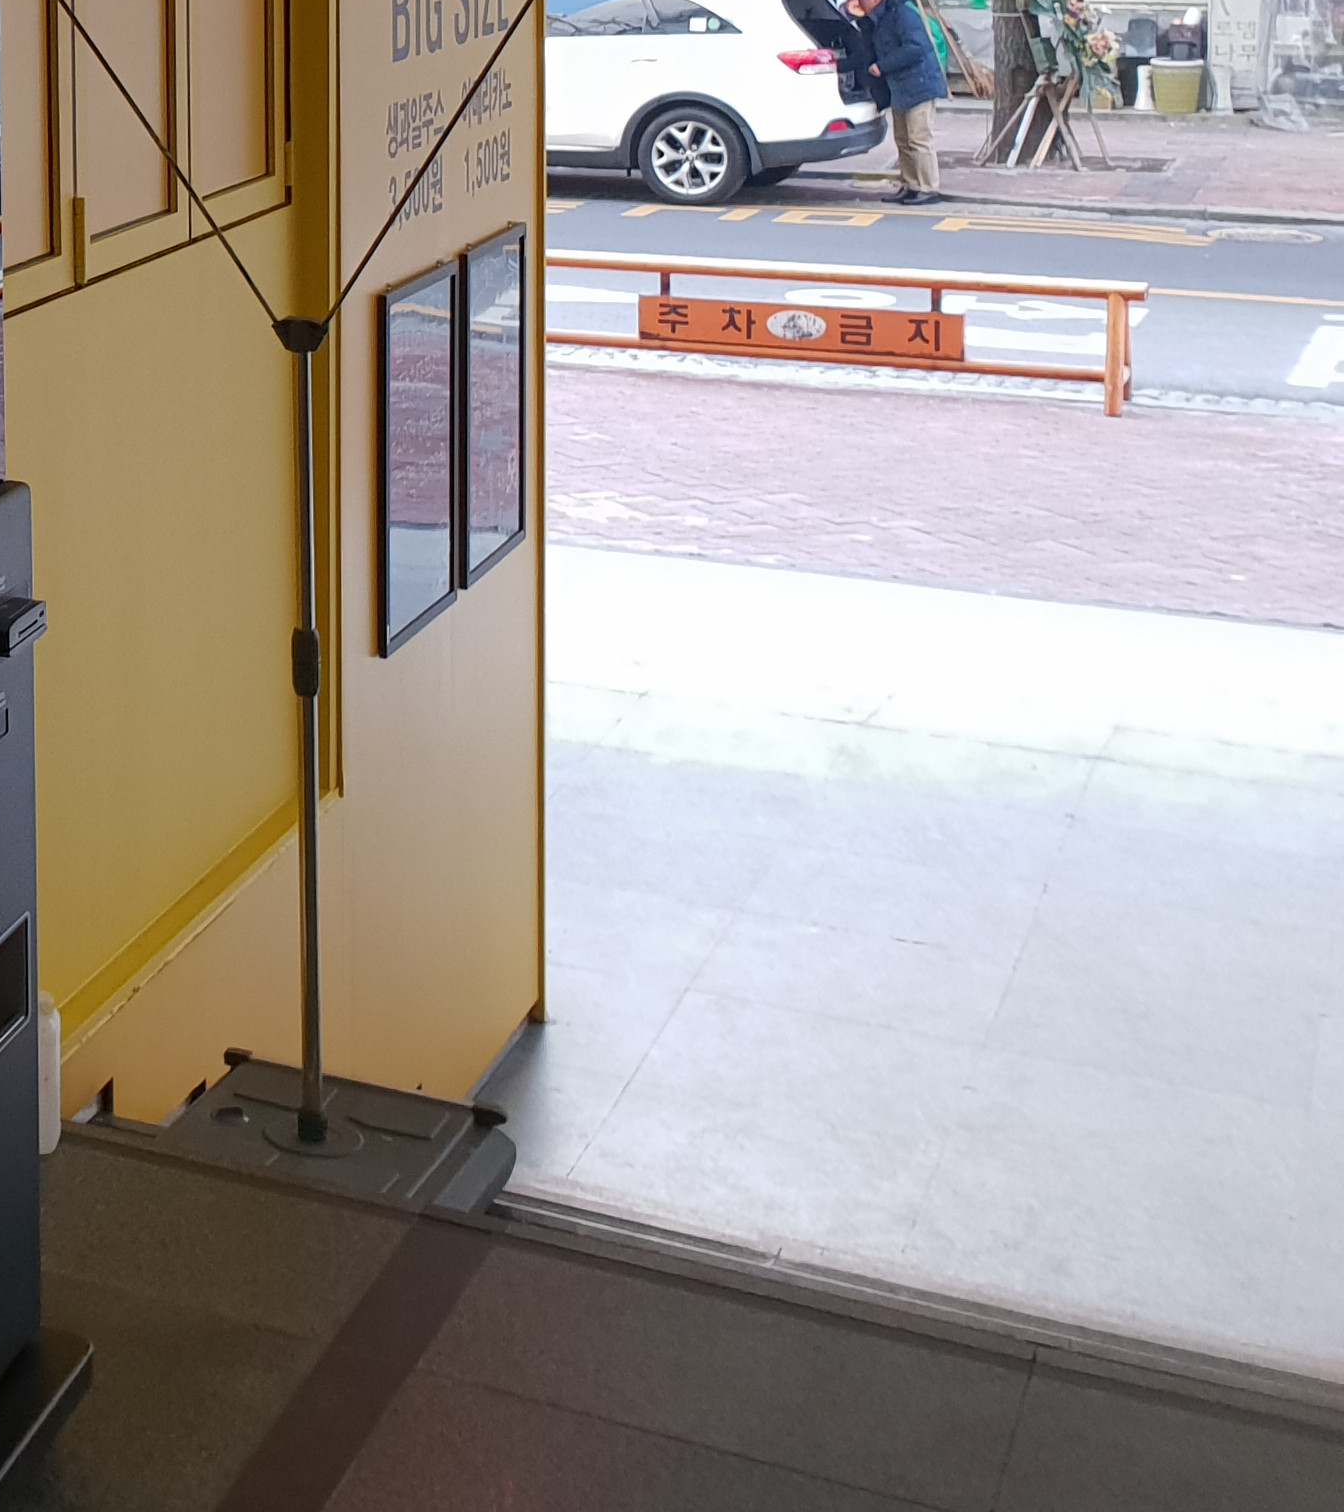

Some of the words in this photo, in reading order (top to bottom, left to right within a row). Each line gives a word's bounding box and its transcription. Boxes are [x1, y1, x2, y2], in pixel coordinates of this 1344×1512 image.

[385, 88, 446, 160] 생과일주스
[464, 128, 511, 199] 1,500원
[656, 301, 757, 341] 주차
[837, 313, 944, 354] 금지
